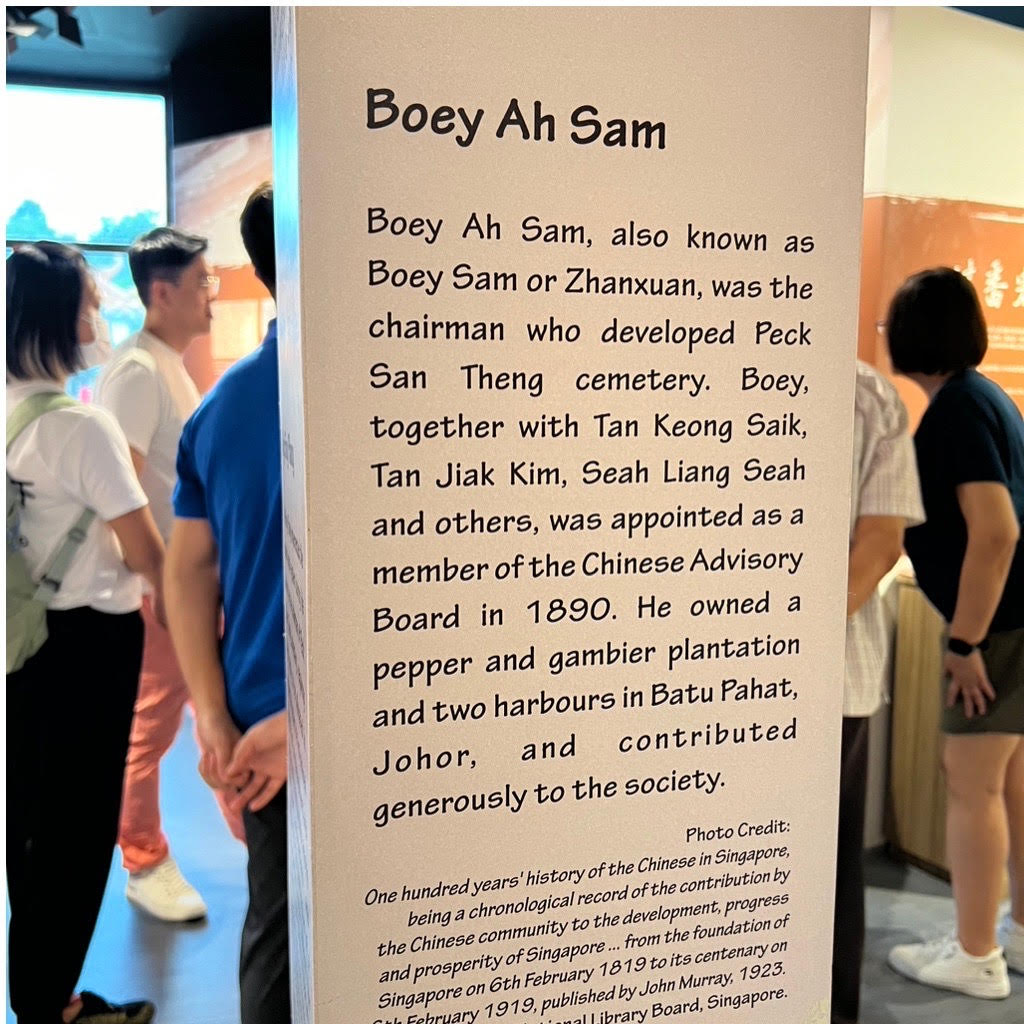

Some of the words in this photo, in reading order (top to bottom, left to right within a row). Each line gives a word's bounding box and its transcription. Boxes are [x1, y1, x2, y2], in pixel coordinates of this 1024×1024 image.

[366, 87, 485, 148] Boey
[495, 97, 556, 143] Ah
[570, 104, 666, 150] Sam
[367, 207, 444, 245] Boey
[461, 211, 501, 241] Ah
[521, 215, 593, 249] Sam,
[611, 220, 669, 248] also
[687, 223, 767, 252] known
[783, 235, 815, 254] as
[368, 259, 444, 296] Boey
[452, 263, 518, 292] Sam
[526, 273, 558, 293] or
[564, 267, 703, 301] Zhanxuan,
[711, 279, 762, 299] was
[768, 274, 814, 300] the
[368, 311, 504, 341] chairman
[526, 315, 581, 343] who
[600, 317, 735, 355] developed
[755, 320, 812, 346] Peck
[369, 362, 427, 390] San
[459, 363, 543, 398] Theng
[575, 368, 711, 398] cemetery.
[741, 366, 809, 398] Boey,
[369, 412, 505, 446] together
[518, 412, 579, 439] with
[593, 412, 639, 438] Tan
[654, 412, 733, 444] Keong
[746, 412, 807, 440] Saik,
[370, 461, 421, 489] Tan
[435, 461, 495, 489] Jiak
[510, 461, 567, 489] Kim,
[582, 459, 649, 485] Seah
[663, 459, 730, 489] Liang
[743, 457, 806, 482] Seah
[371, 509, 425, 537] and
[435, 508, 539, 536] others,
[549, 512, 603, 532] was
[610, 502, 743, 540] appointed
[751, 508, 782, 527] as
[789, 508, 804, 526] a
[373, 556, 490, 585] member
[494, 553, 525, 580] of
[528, 552, 576, 579] the
[581, 551, 685, 577] Chinese
[689, 547, 804, 575] Advisory
[373, 603, 460, 633] Board
[481, 602, 504, 627] in
[526, 596, 617, 624] 1890.
[637, 594, 672, 619] He
[689, 590, 770, 617] owned
[787, 595, 801, 613] a
[373, 656, 473, 691] pepper
[485, 645, 535, 673] and
[548, 641, 657, 676] gambier
[668, 634, 800, 671] plantation
[372, 699, 425, 729] and
[431, 701, 487, 723] two
[494, 689, 616, 718] harbours
[622, 685, 644, 709] in
[650, 682, 714, 707] Batu
[720, 676, 798, 702] Pahat,
[372, 745, 477, 776] Johor,
[521, 732, 576, 762] and
[618, 716, 797, 753] contributed
[373, 783, 528, 828] generously
[533, 783, 565, 805] to
[571, 775, 618, 801] the
[624, 769, 726, 796] society.
[686, 826, 735, 843] Photo
[737, 819, 791, 838] Credit:
[364, 888, 398, 906] One
[400, 877, 471, 902] hundred
[525, 868, 586, 887] history
[587, 861, 607, 879] of
[607, 860, 635, 877] the
[637, 856, 697, 874] Chinese
[698, 851, 712, 867] in
[714, 846, 790, 866] Singapore,
[407, 908, 452, 928] being
[454, 909, 466, 922] a
[468, 890, 576, 920] chronological
[577, 884, 630, 906] record
[630, 881, 650, 899] of
[650, 880, 677, 897] the
[679, 870, 771, 894] contribution
[772, 866, 791, 885] by
[376, 939, 407, 958] the
[410, 933, 476, 953] Chinese
[478, 919, 569, 944] community
[571, 917, 590, 932] to
[593, 911, 621, 929] the
[622, 900, 722, 925] development,
[723, 893, 790, 918] progress
[378, 963, 412, 984] and
[412, 953, 504, 985] prosperity
[505, 947, 525, 966] of
[525, 941, 606, 964] Singapore
[624, 933, 661, 950] from
[663, 927, 690, 944] the
[692, 918, 772, 940] foundation
[773, 912, 791, 930] of
[378, 986, 463, 1010] Singapore
[465, 983, 486, 997] on
[489, 974, 521, 993] 6th
[524, 967, 595, 989] February
[599, 956, 647, 977] 1819
[649, 956, 668, 970] to
[669, 952, 692, 968] its
[694, 943, 770, 964] centenary
[770, 941, 788, 954] on
[484, 997, 538, 1019] 1919,
[540, 984, 617, 1017] published
[617, 983, 638, 1002] by
[638, 978, 676, 997] John
[678, 972, 734, 990] Murray,
[739, 961, 786, 981] 1923.
[591, 1008, 649, 1024] Library
[651, 996, 704, 1019] Board,
[707, 988, 788, 1010] Singapore.
